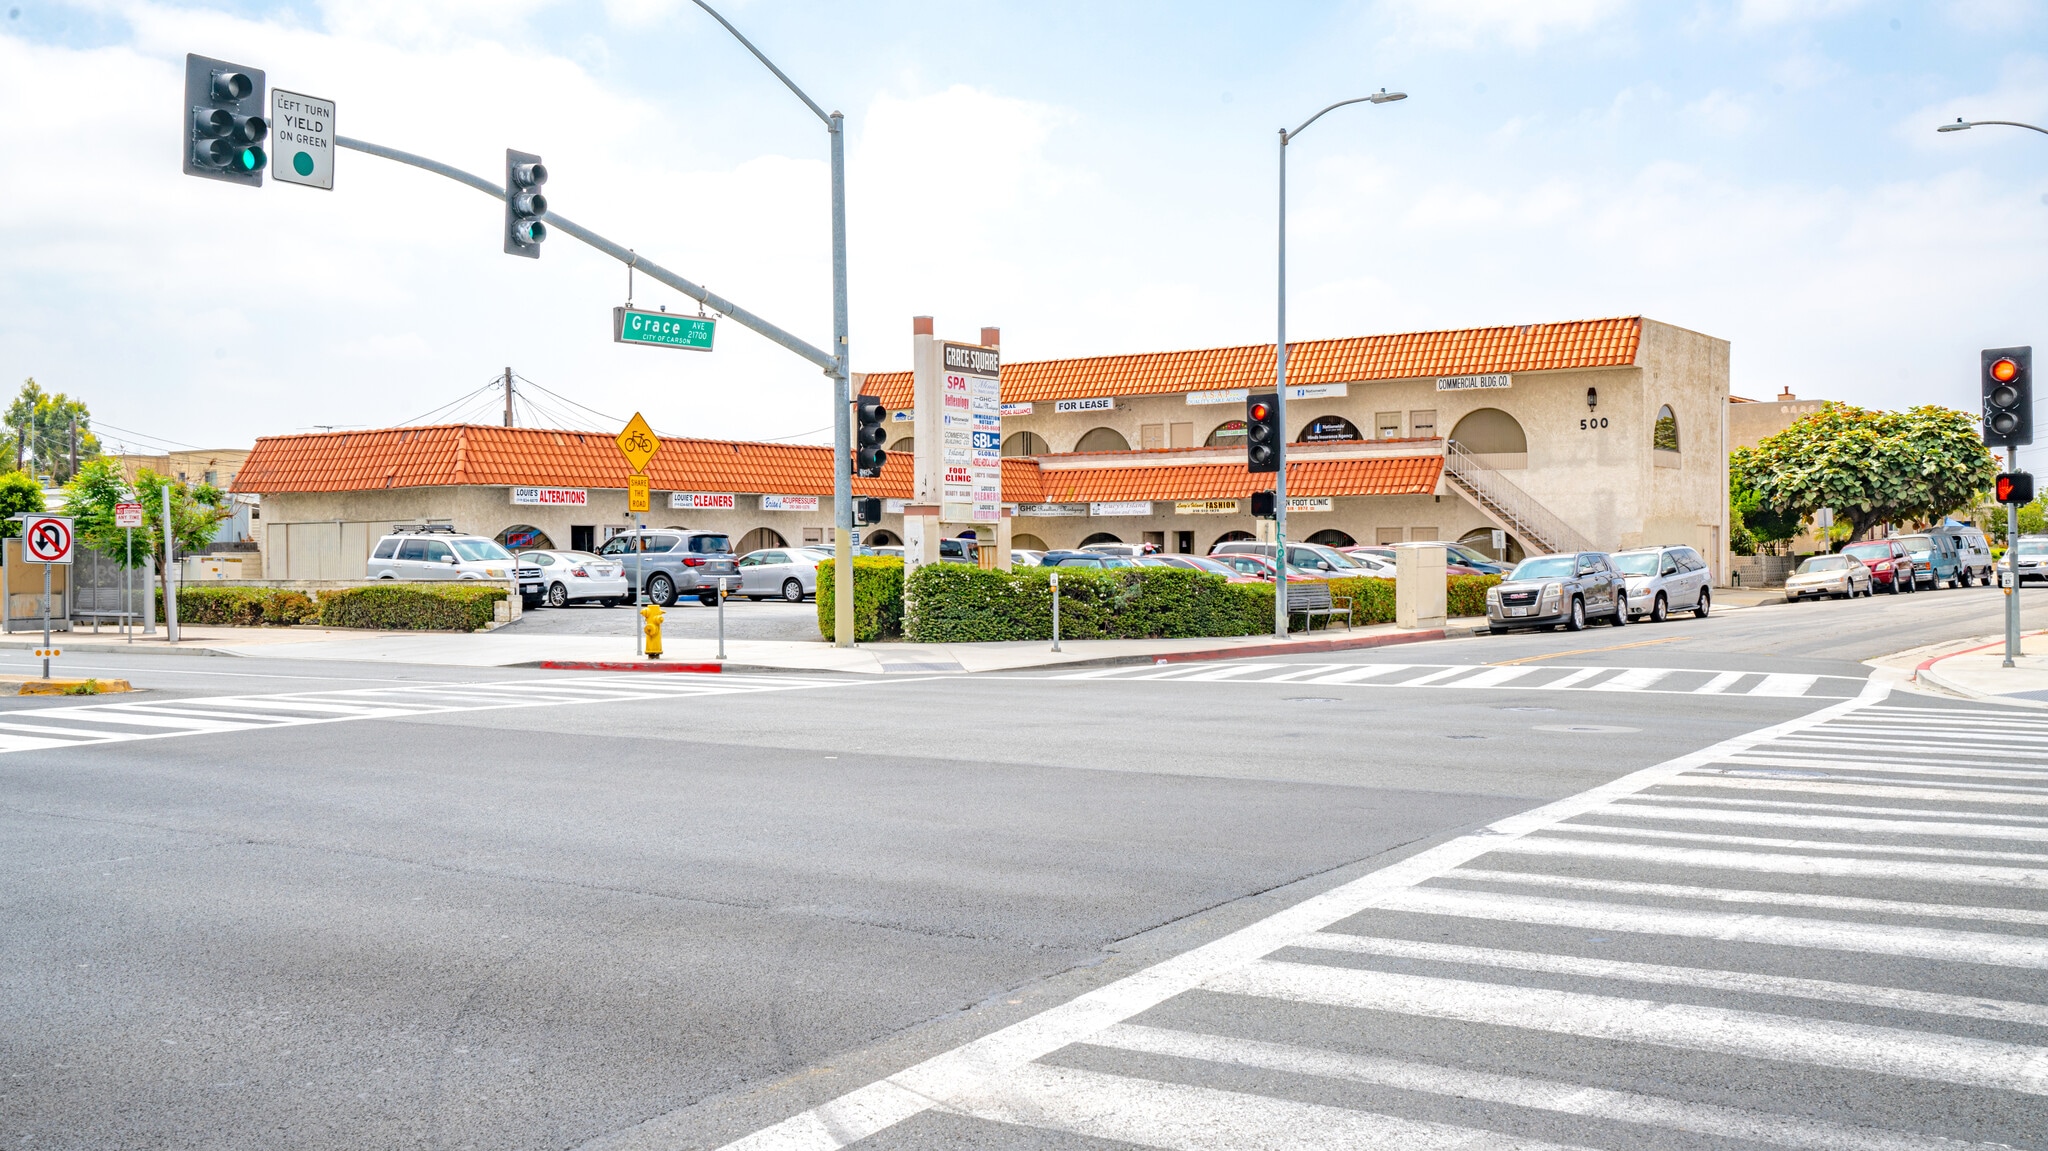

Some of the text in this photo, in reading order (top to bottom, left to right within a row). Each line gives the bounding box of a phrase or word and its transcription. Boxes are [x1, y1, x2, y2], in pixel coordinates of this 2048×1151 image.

[278, 98, 330, 118] LEFT TURN
[284, 114, 324, 132] YIELD
[280, 130, 327, 148] ON GREEN
[632, 316, 705, 334] Grace AVE
[666, 336, 691, 344] CARSON
[688, 330, 708, 340] 21700
[946, 347, 998, 372] GRACE SQUARE
[948, 376, 966, 390] SPA
[1438, 375, 1509, 390] COMMERCIAL BLDG. CO.
[1058, 400, 1109, 411] FOR LEASE
[1580, 417, 1609, 430] 500
[945, 432, 970, 440] COMMERCIAL
[974, 433, 992, 448] SBL
[949, 466, 967, 474] FOOT
[630, 479, 647, 488] SHARE
[946, 474, 972, 482] CLINIC
[516, 488, 586, 504] LOUIE'S ALTERATIONS
[634, 490, 644, 498] THE
[974, 492, 1000, 502] CLEANERS
[632, 500, 646, 508] ROAD
[694, 494, 733, 508] CLEANERS
[782, 496, 816, 505] ACUPRESSURE
[974, 510, 1000, 520] ALTERATIONS
